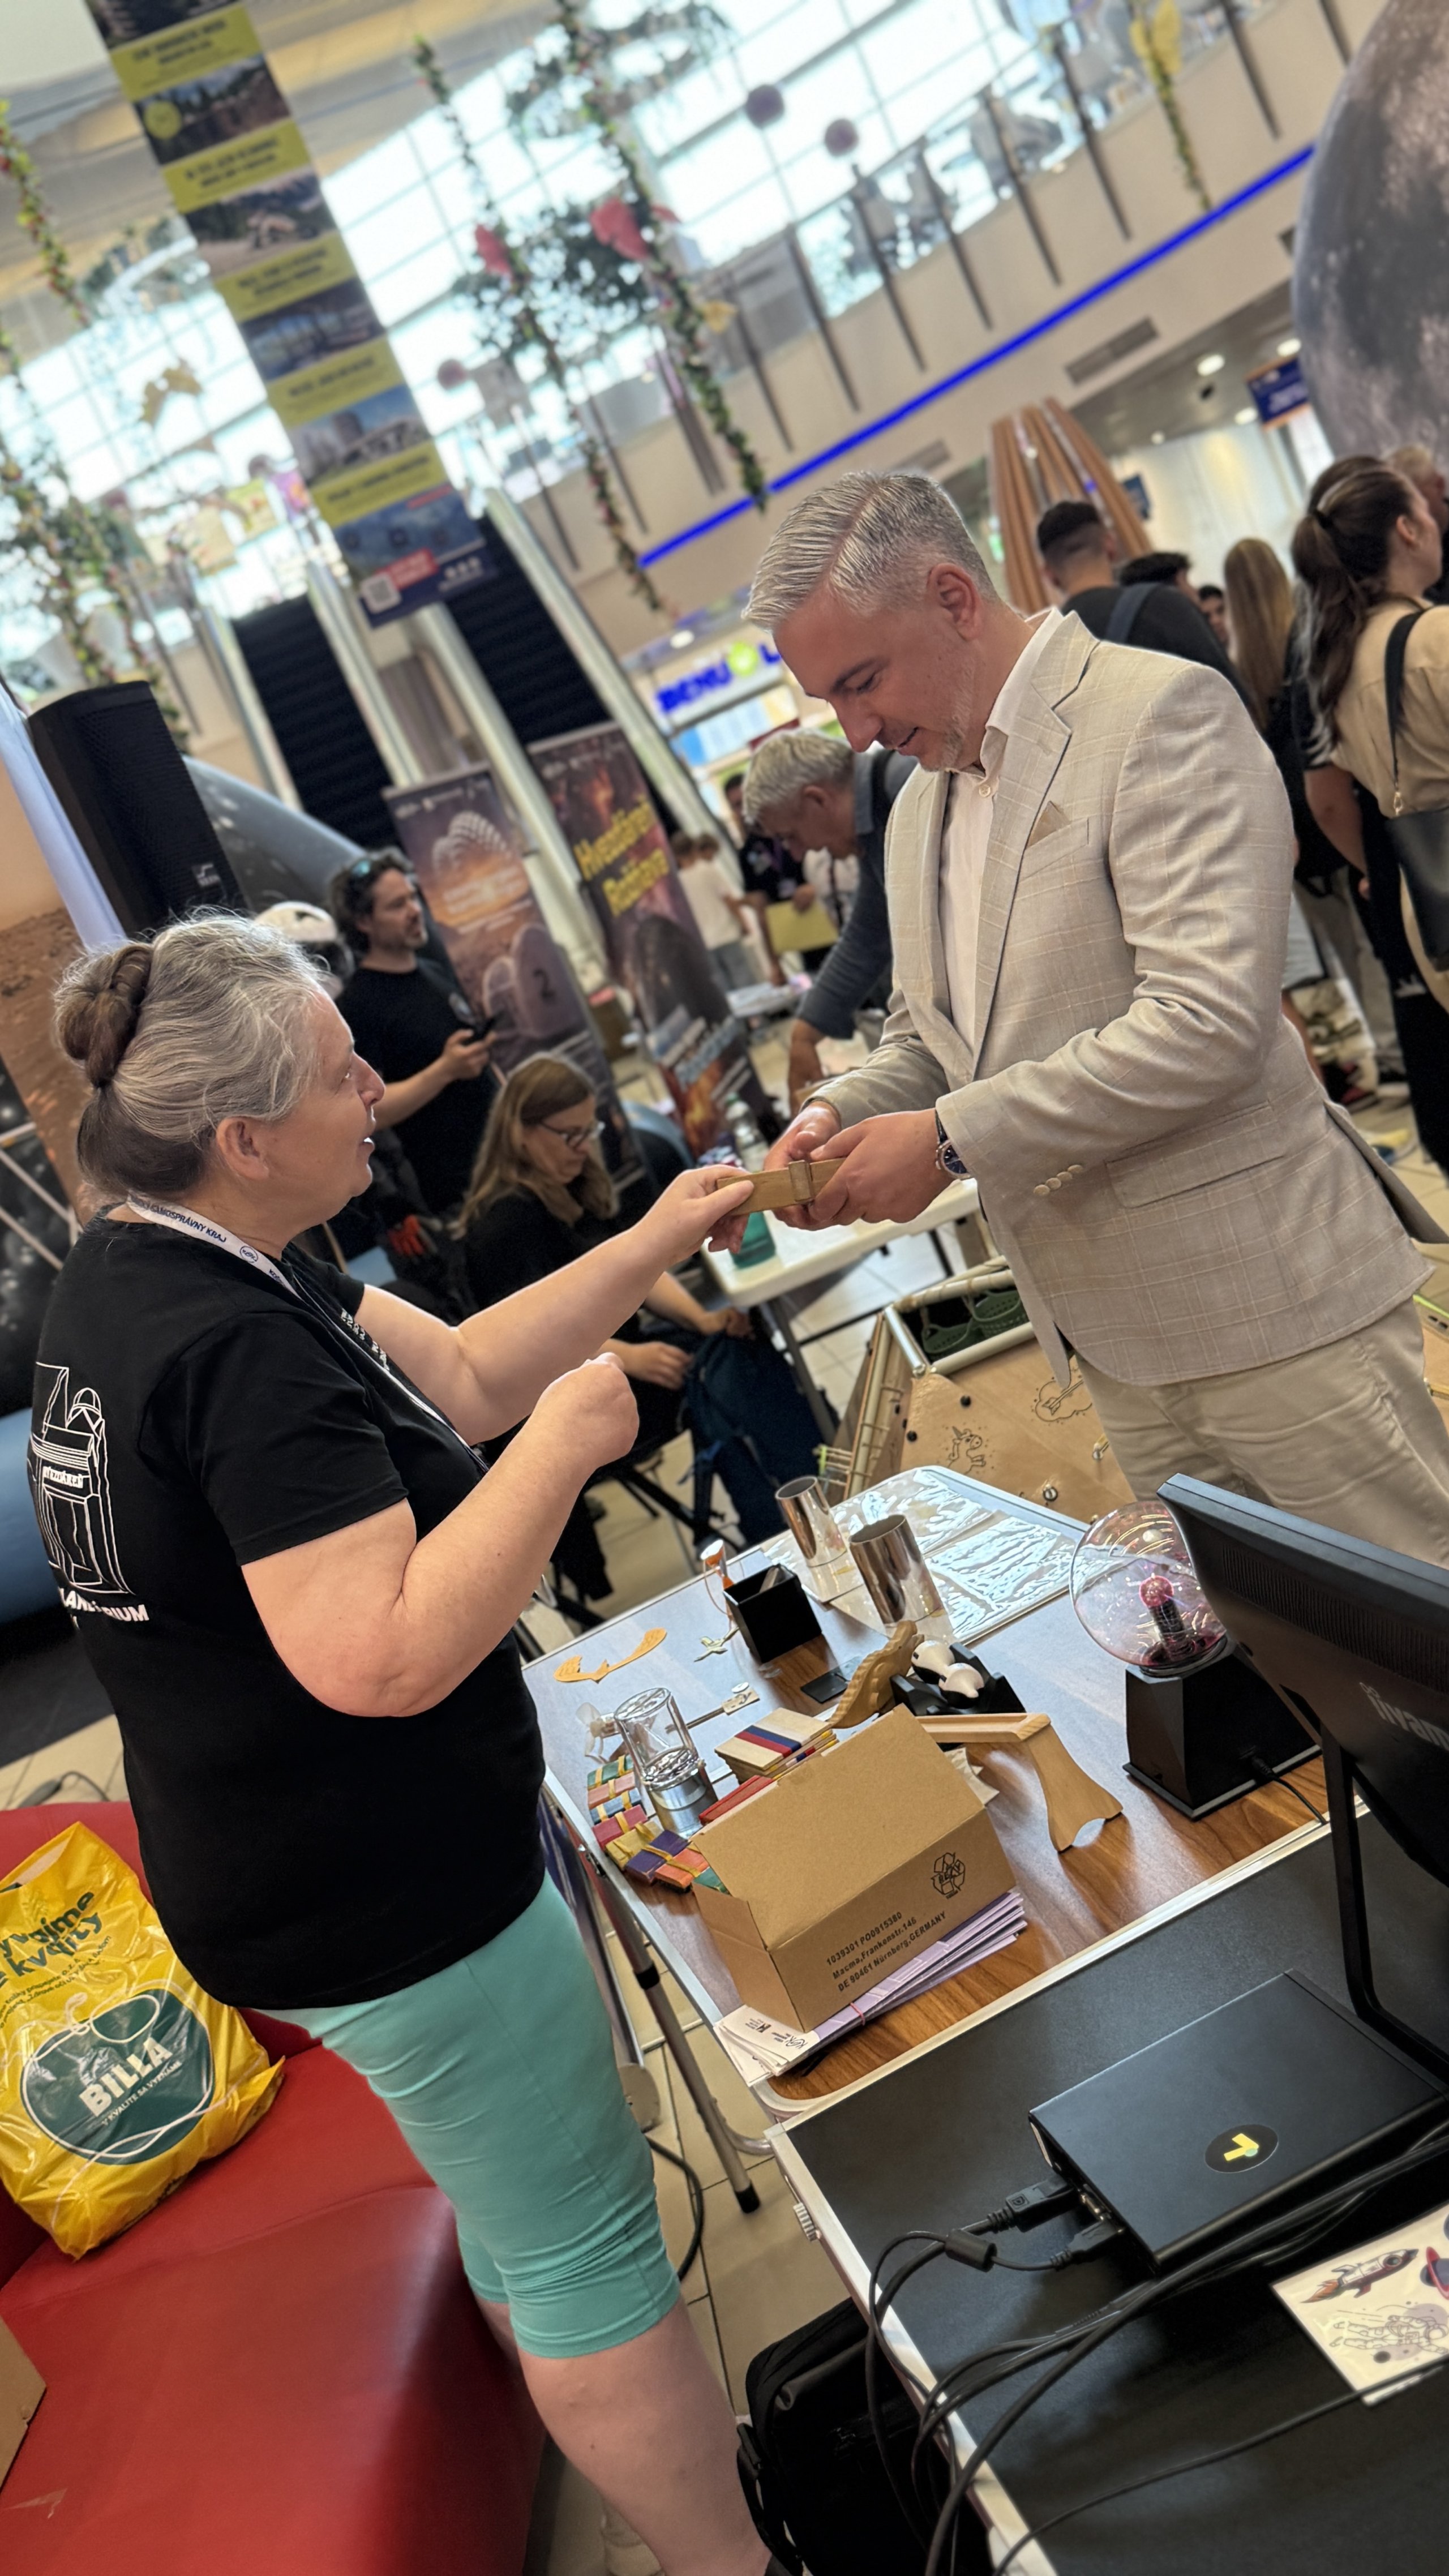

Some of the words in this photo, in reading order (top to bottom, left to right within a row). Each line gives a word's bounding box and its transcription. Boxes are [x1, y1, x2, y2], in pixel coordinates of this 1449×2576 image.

[205, 1227, 226, 1242] KRAJ
[826, 1941, 859, 1966] 1039301
[838, 1980, 850, 1992] DE
[850, 1962, 873, 1983] 90461
[79, 2037, 173, 2118] BILLA
